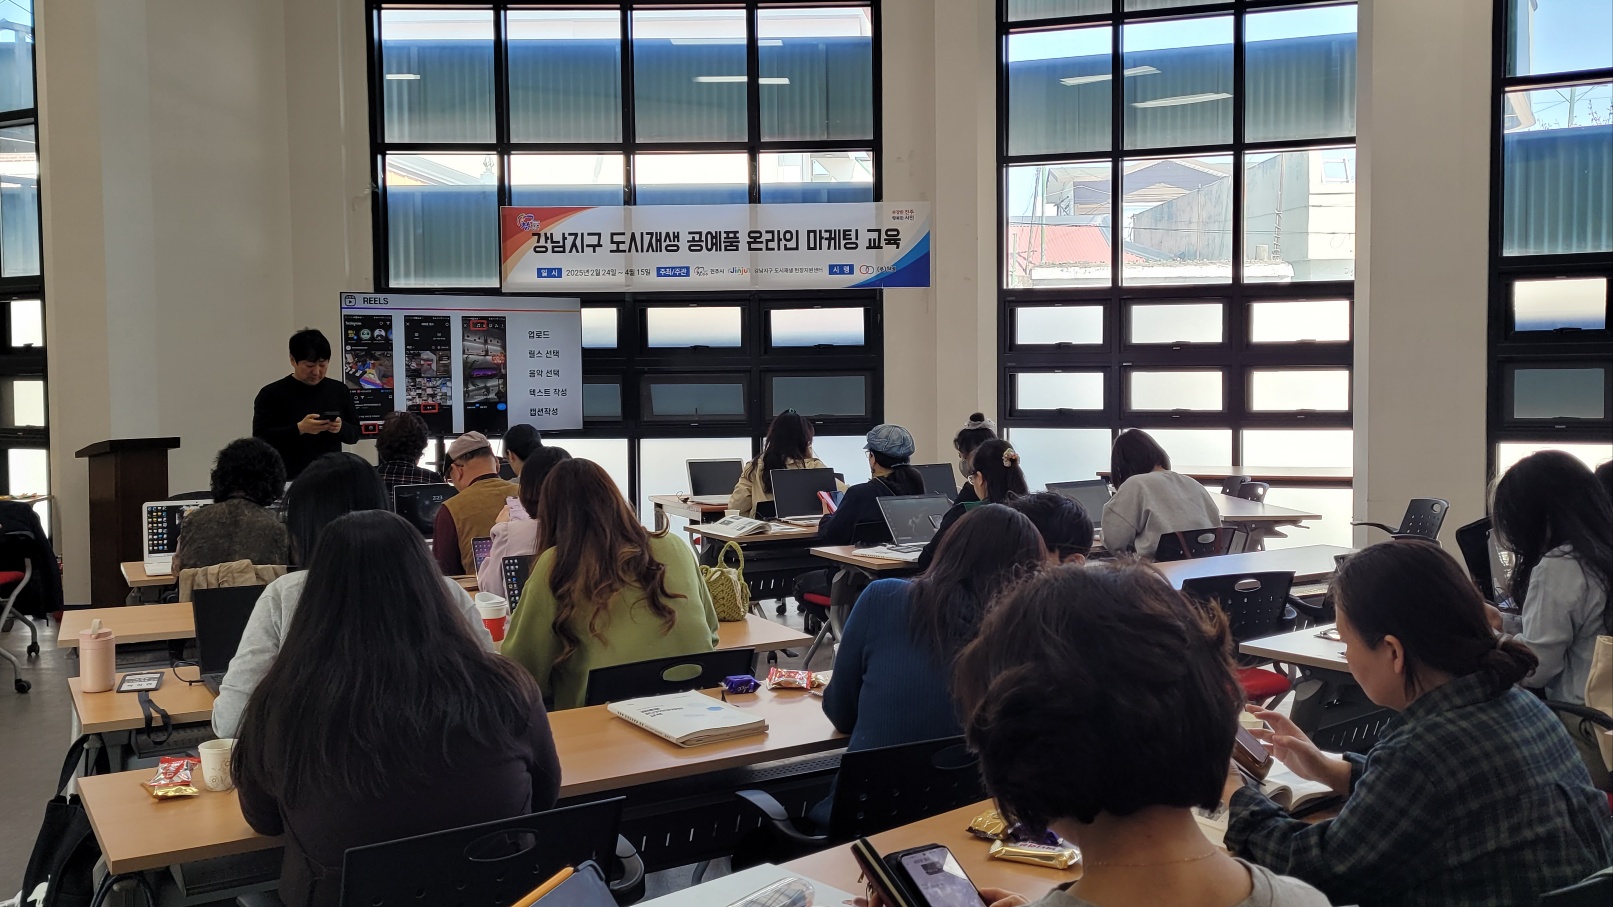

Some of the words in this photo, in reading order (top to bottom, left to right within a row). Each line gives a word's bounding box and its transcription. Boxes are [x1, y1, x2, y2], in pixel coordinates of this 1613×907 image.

[531, 232, 603, 254] 강남지구
[609, 231, 681, 254] 도시재생
[687, 230, 741, 253] 공예품
[746, 229, 800, 252] 온라인
[806, 228, 859, 251] 마케팅
[865, 228, 902, 250] 교육
[566, 268, 590, 277] 2025년
[601, 268, 617, 277] 24일
[624, 268, 635, 277] 4월
[637, 268, 651, 276] 15일
[659, 268, 687, 276] 주최/주관
[730, 266, 749, 275] Jinju
[362, 296, 389, 305] REELS
[528, 330, 550, 339] 업로드
[528, 349, 543, 358] 릴스
[545, 349, 560, 358] 선택
[528, 369, 543, 378] 음악
[545, 369, 560, 378] 선택
[529, 388, 551, 397] 텍스트
[553, 388, 568, 397] 작성
[529, 407, 559, 417] 캡션작성
